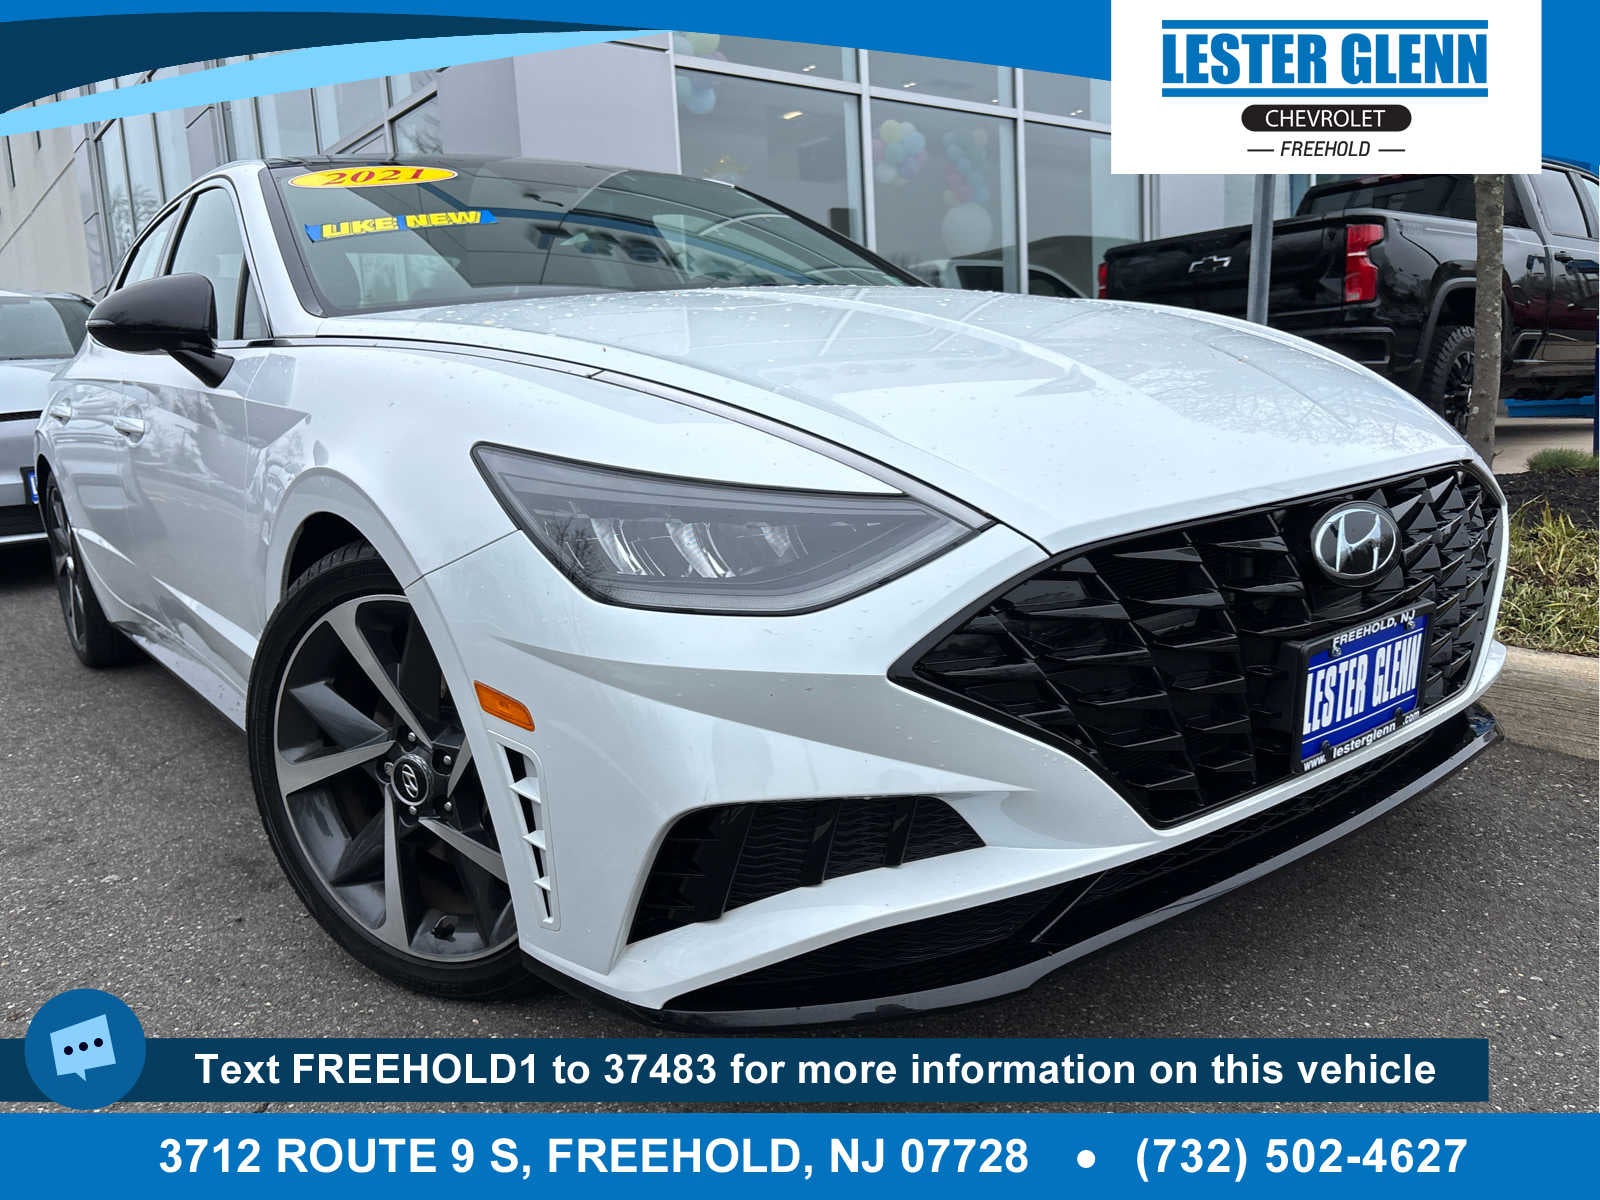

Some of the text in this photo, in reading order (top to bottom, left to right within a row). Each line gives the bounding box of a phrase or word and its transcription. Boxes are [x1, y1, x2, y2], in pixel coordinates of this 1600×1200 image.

[322, 168, 425, 185] 2021
[322, 211, 481, 239] LIKE NEW
[1332, 609, 1416, 648] FREEHOLD, NJ
[1302, 632, 1423, 736] LESTER GLENN
